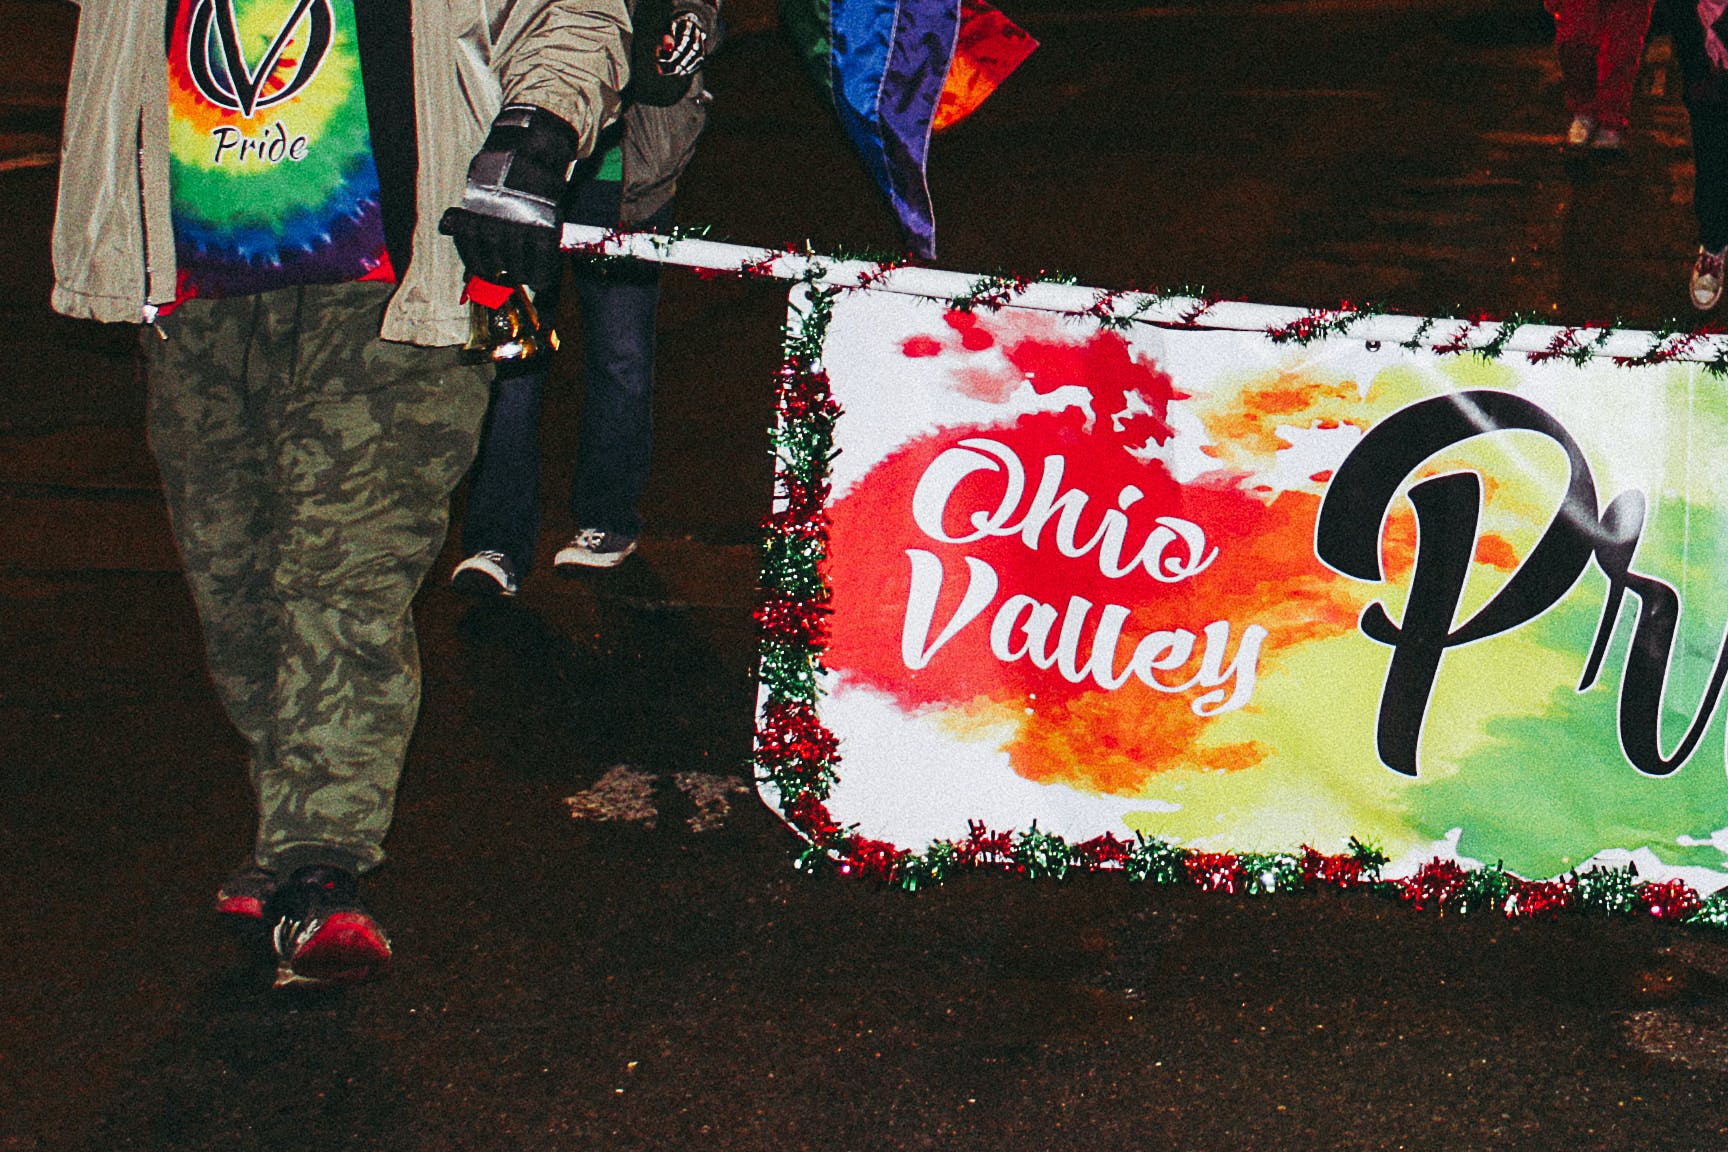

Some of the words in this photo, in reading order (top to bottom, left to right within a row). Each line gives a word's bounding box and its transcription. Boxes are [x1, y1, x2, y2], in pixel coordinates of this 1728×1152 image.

[212, 120, 309, 165] Pride
[912, 438, 1219, 583] Ohio
[902, 549, 1269, 717] Valley
